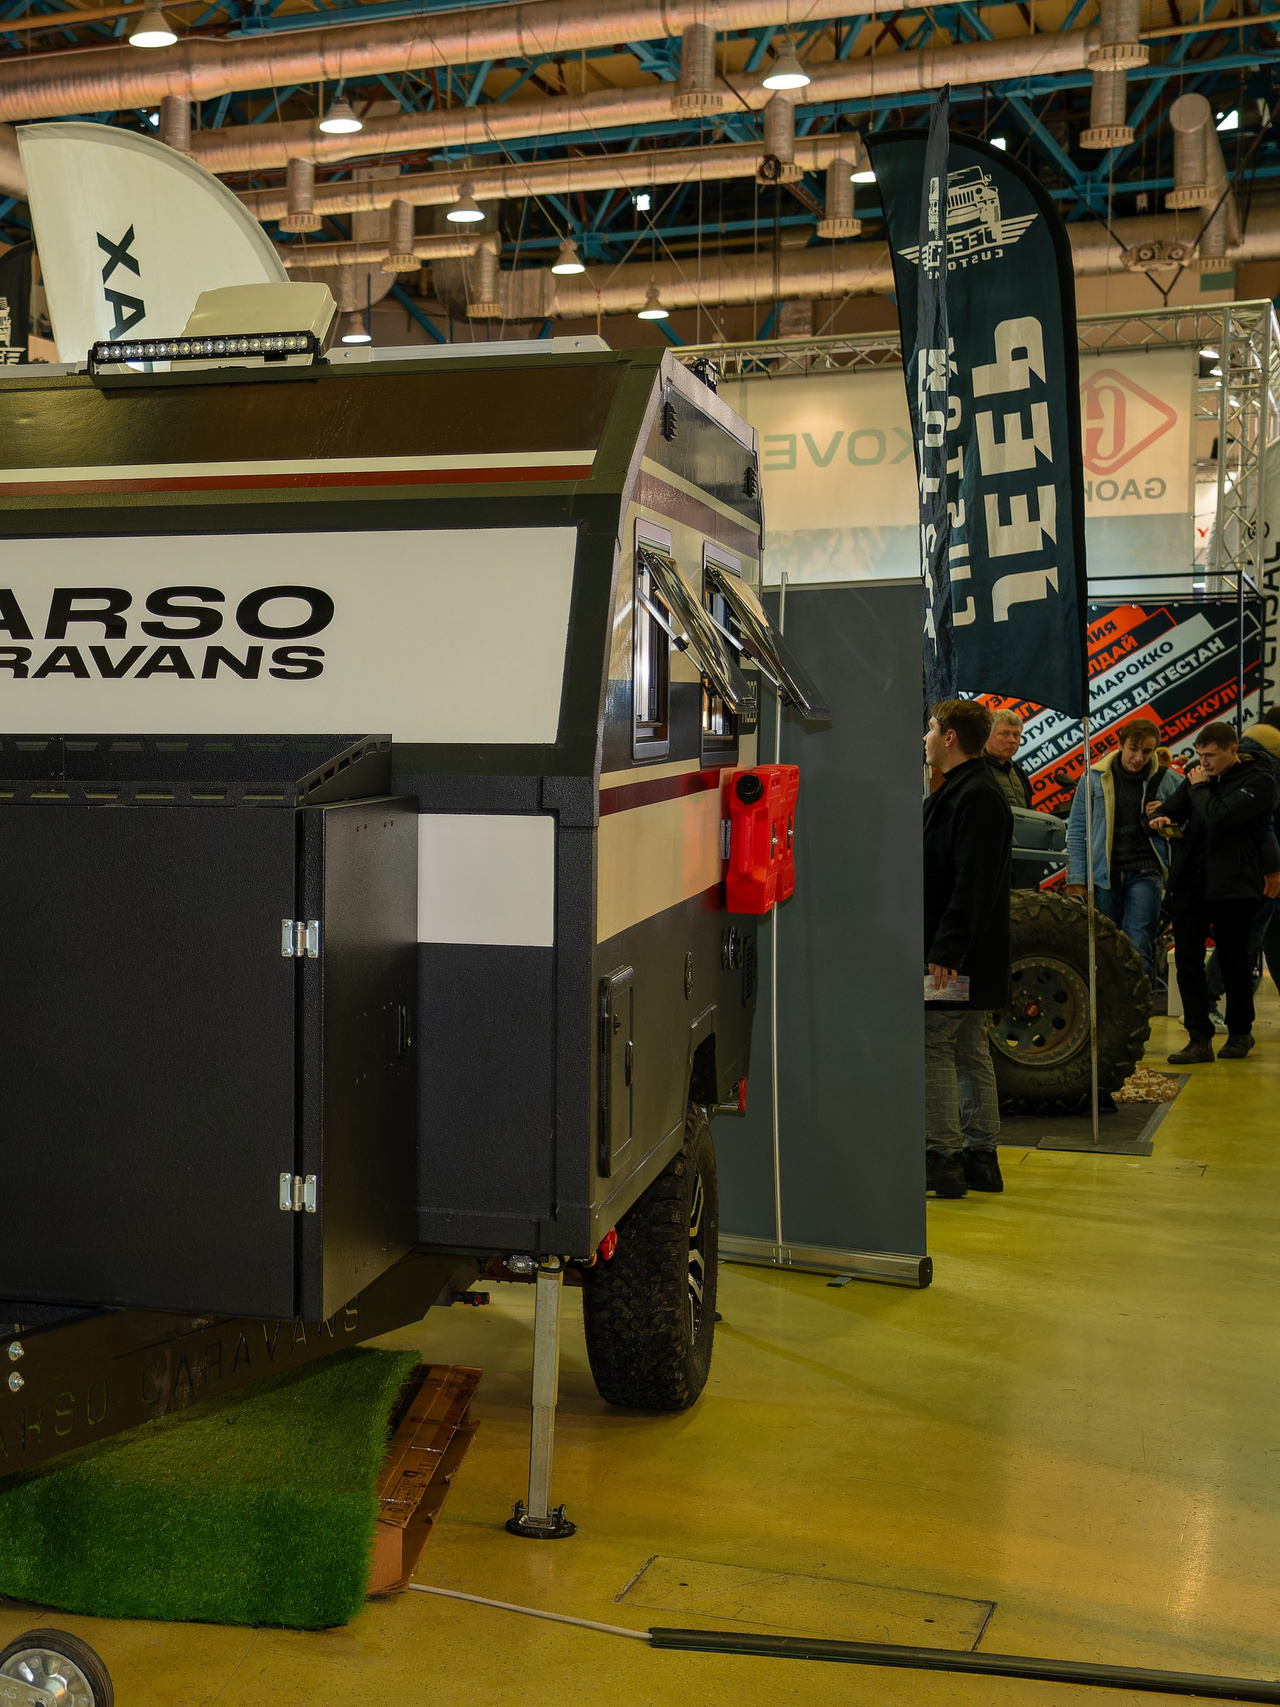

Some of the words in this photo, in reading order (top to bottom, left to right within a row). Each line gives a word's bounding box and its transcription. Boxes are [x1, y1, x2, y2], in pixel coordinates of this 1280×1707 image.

[1088, 635, 1138, 676] ЛДАЙ
[1089, 641, 1174, 701] МАРОККО
[1021, 741, 1059, 773] НЫЙ
[1131, 637, 1226, 705] ДАГЕСТАН
